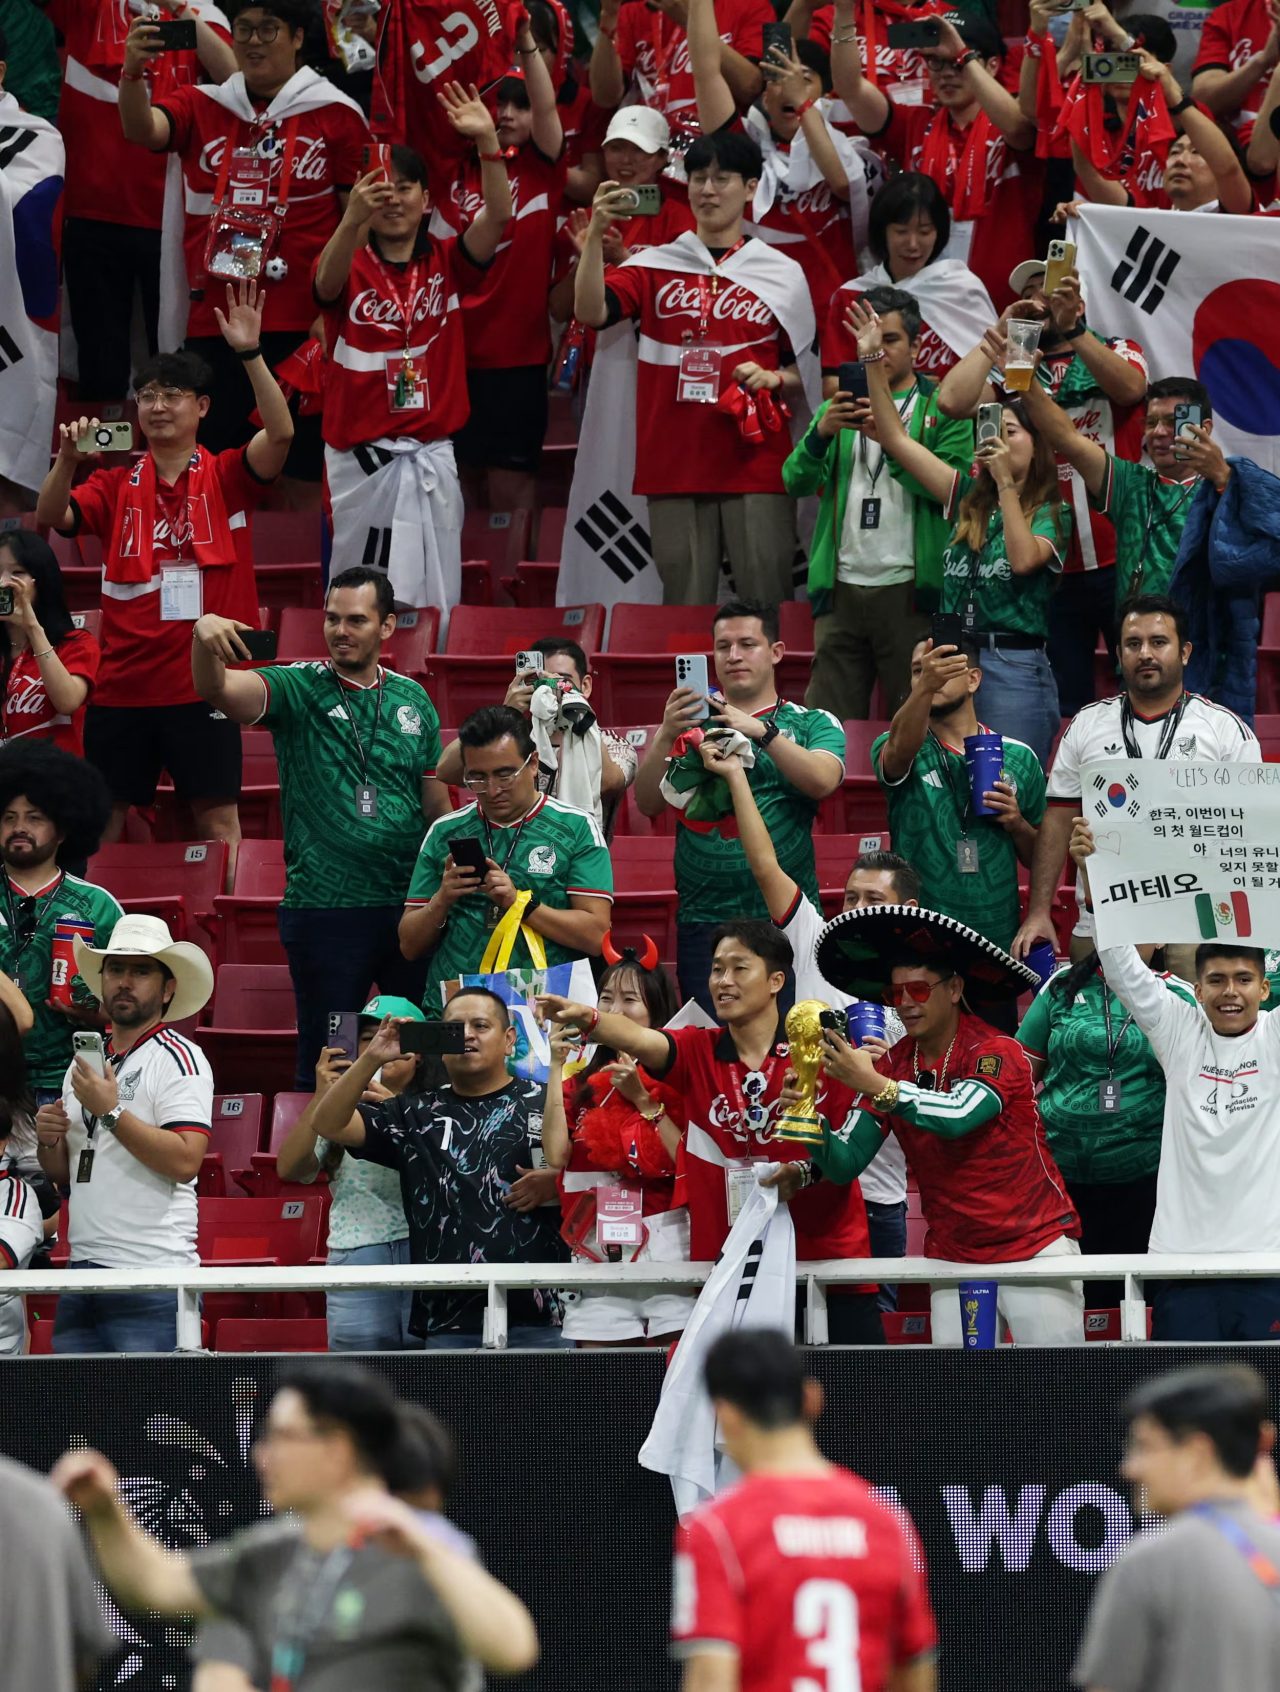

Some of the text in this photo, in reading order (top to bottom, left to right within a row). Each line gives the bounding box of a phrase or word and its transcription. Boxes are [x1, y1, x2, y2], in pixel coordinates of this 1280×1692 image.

[631, 733, 643, 743] 17
[1176, 767, 1280, 788] LET'S GO COREA
[1149, 807, 1245, 821] 한국, 이번이 나
[1153, 824, 1244, 838] 의 첫 월드컵이
[191, 849, 203, 859] 15
[1193, 842, 1207, 857] 야
[1220, 846, 1248, 858] 너의
[1219, 861, 1247, 873] 잊지
[1251, 861, 1278, 873] 못할
[1233, 876, 1247, 888] 이
[228, 1102, 240, 1112] 16
[288, 1205, 300, 1215] 17
[1089, 1317, 1106, 1328] 22
